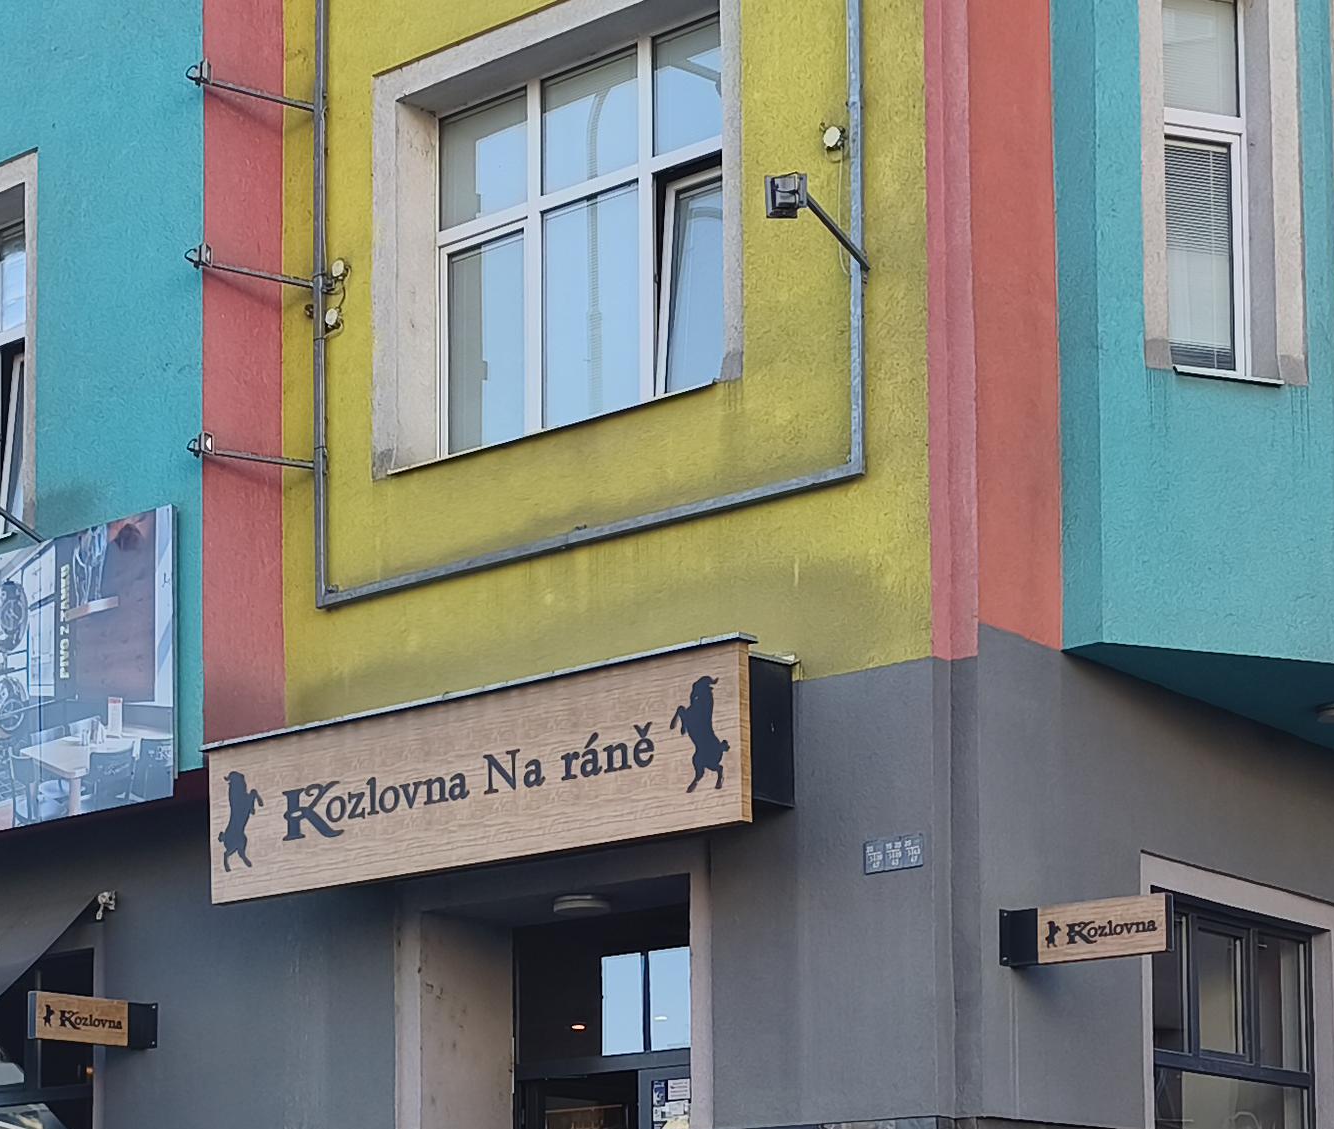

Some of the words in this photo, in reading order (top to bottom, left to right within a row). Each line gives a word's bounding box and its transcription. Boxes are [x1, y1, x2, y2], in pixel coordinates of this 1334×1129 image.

[60, 624, 69, 635] Z
[60, 639, 69, 678] PIVO
[282, 772, 470, 841] Kozlovna
[483, 748, 545, 795] Na
[560, 722, 655, 781] ráně
[1066, 919, 1158, 944] Kozlovna
[59, 1009, 123, 1030] Kozlovna
